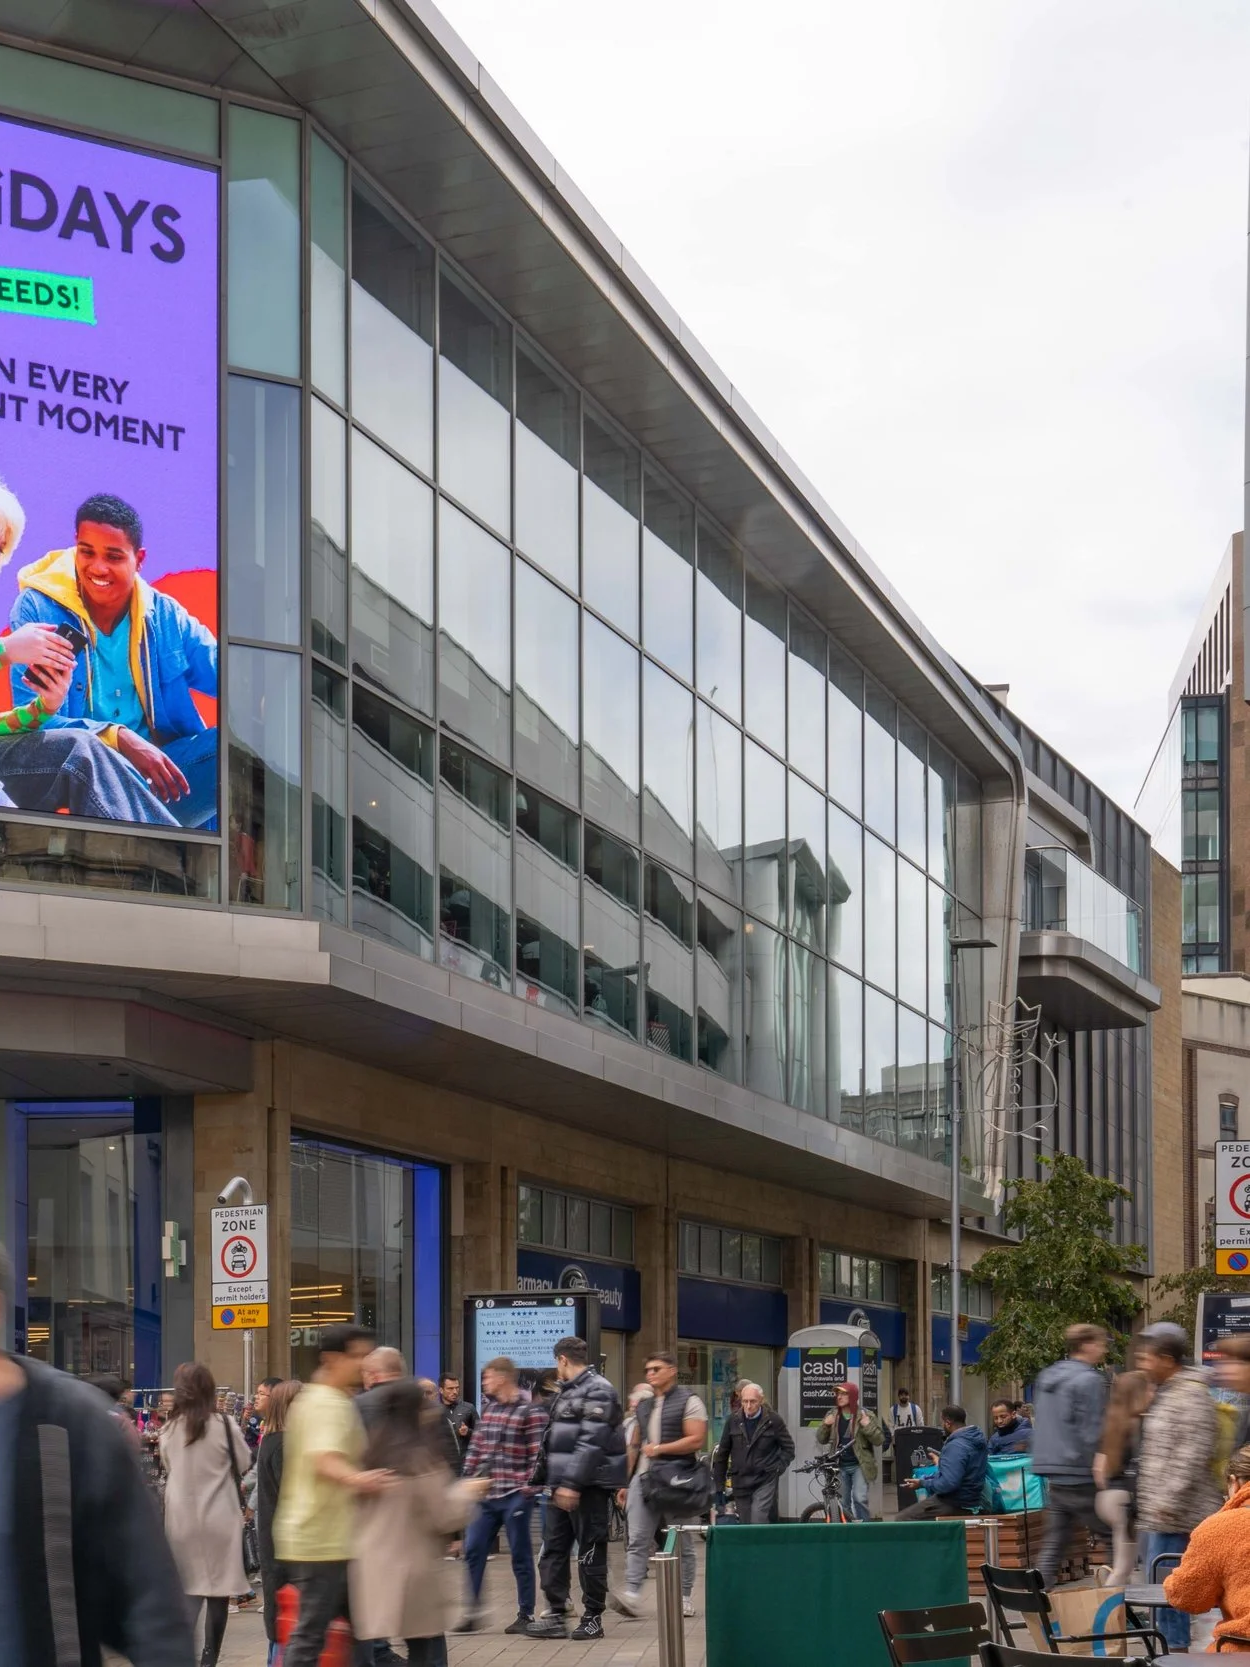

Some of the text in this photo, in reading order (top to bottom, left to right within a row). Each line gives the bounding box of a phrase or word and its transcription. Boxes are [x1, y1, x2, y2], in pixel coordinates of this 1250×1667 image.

[28, 360, 131, 405] EVERY
[37, 398, 186, 452] MOMENT
[215, 1208, 264, 1218] PEDESTRIAN
[222, 1220, 257, 1232] ZONE
[228, 1285, 252, 1294] Except
[214, 1292, 266, 1303] permit holders
[237, 1308, 260, 1316] At any
[802, 1358, 845, 1375] cash
[862, 1361, 877, 1376] cash
